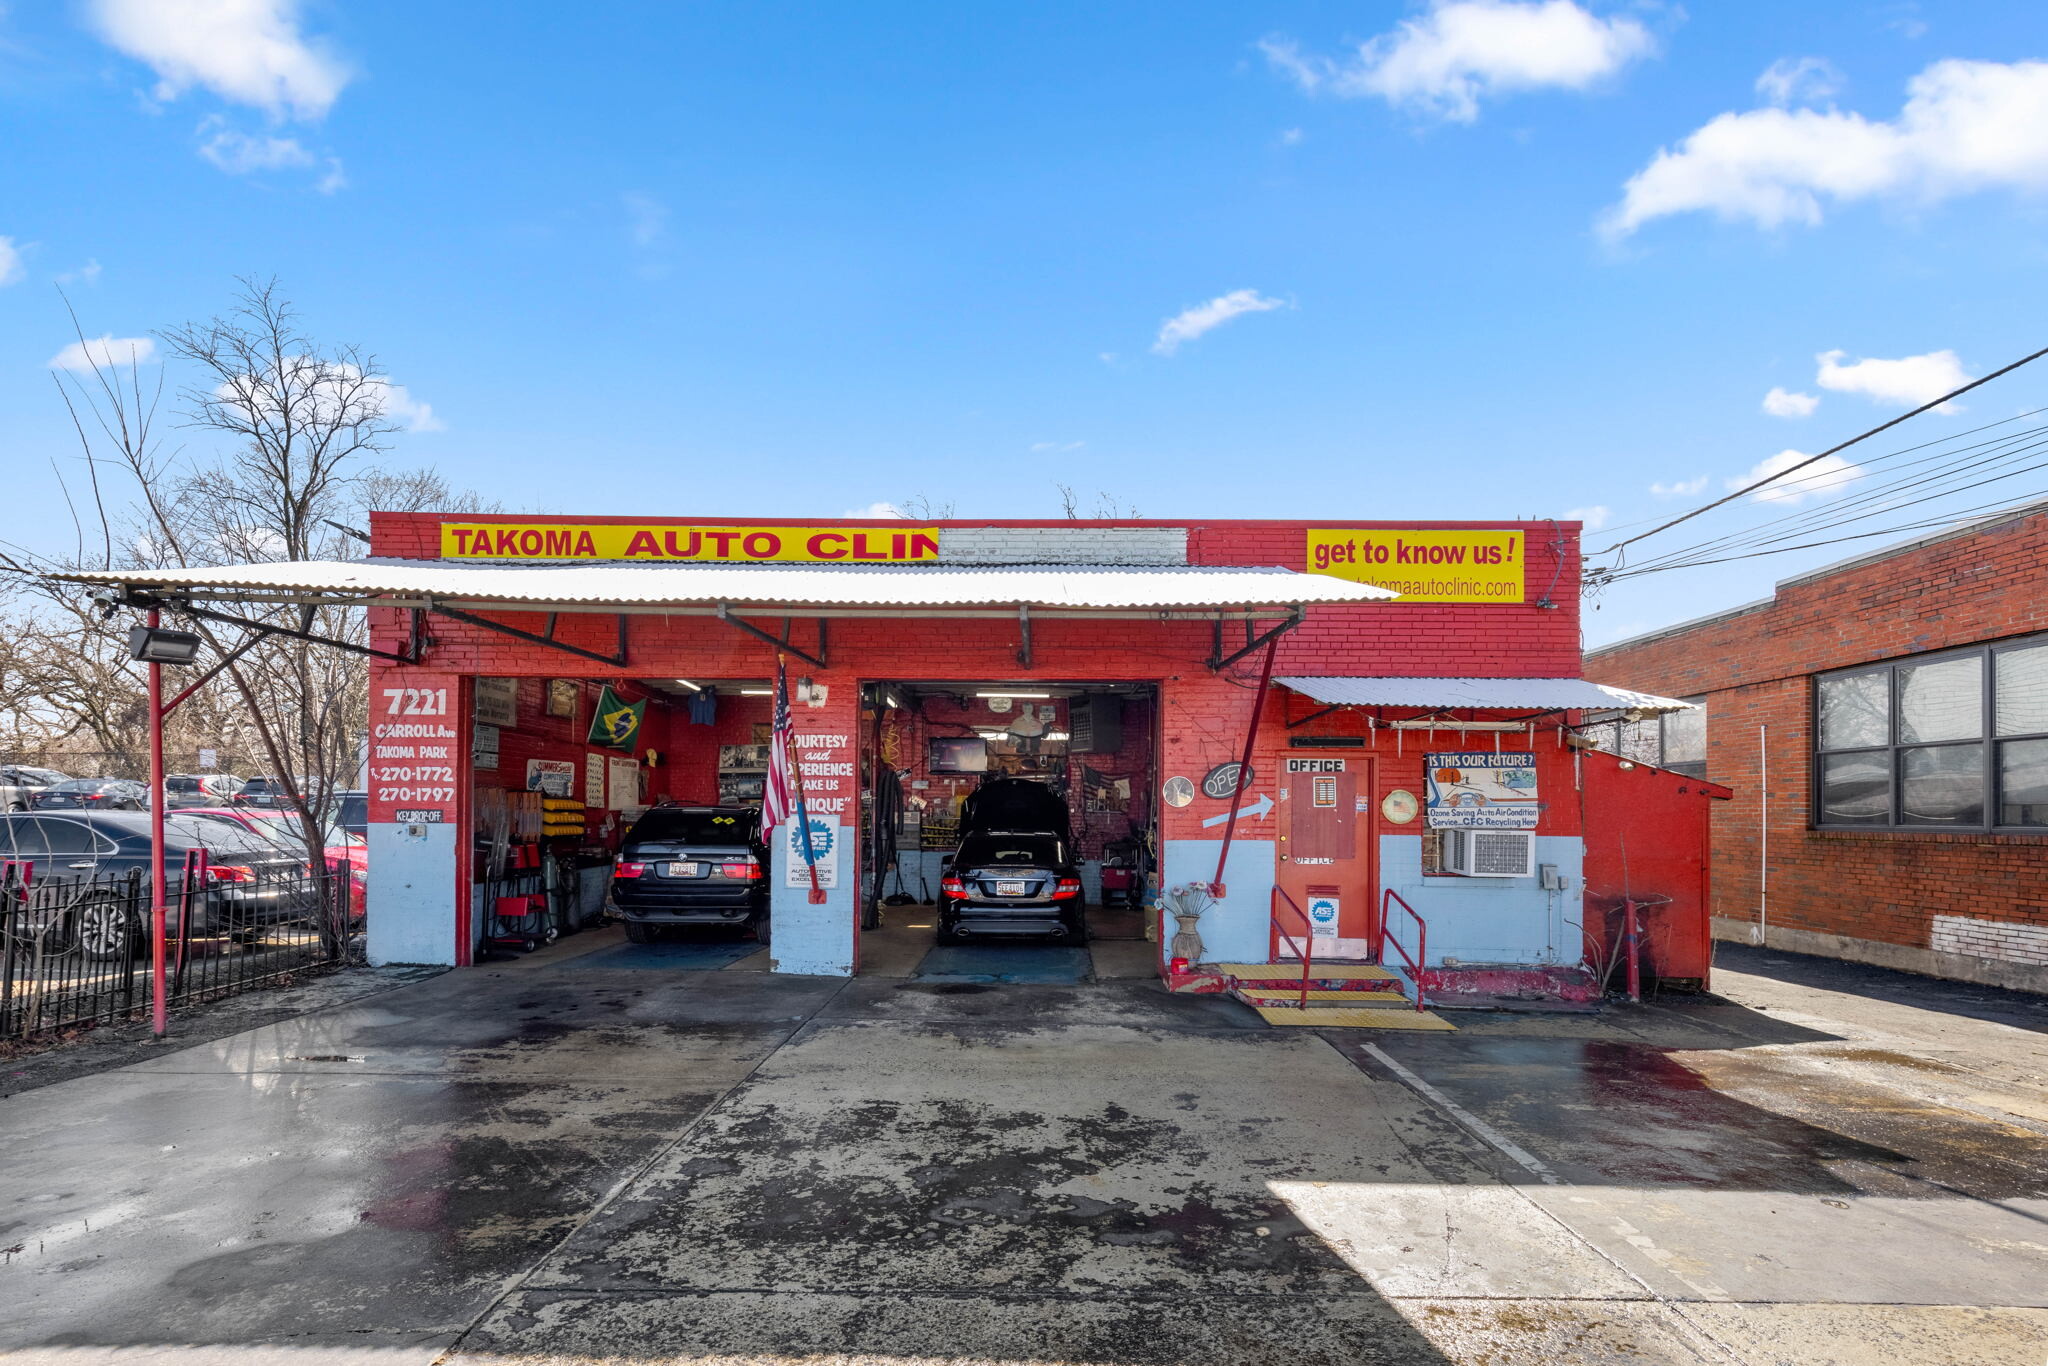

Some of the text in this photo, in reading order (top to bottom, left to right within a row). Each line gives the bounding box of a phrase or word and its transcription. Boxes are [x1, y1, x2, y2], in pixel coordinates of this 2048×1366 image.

[452, 529, 939, 560] TAKOMA AUTO CLIN
[1314, 539, 1356, 569] get
[1363, 539, 1389, 564] to
[1396, 538, 1467, 565] know
[383, 688, 447, 715] 7221
[375, 724, 457, 738] CARROLL Ave
[787, 734, 848, 749] OURTESY
[375, 746, 448, 759] TAKOMA PARK
[804, 749, 832, 761] and
[1289, 760, 1343, 772] OFFICE
[1429, 755, 1439, 767] IS
[1440, 755, 1461, 767] THIS
[1461, 755, 1486, 767] OUR
[380, 766, 454, 782] 270-1772
[825, 779, 839, 791] US
[378, 787, 455, 802] 270-1797
[1430, 808, 1537, 819] Ozone Saving Auto Air Condition
[1485, 818, 1521, 828] Recycling
[1522, 818, 1537, 826] Here
